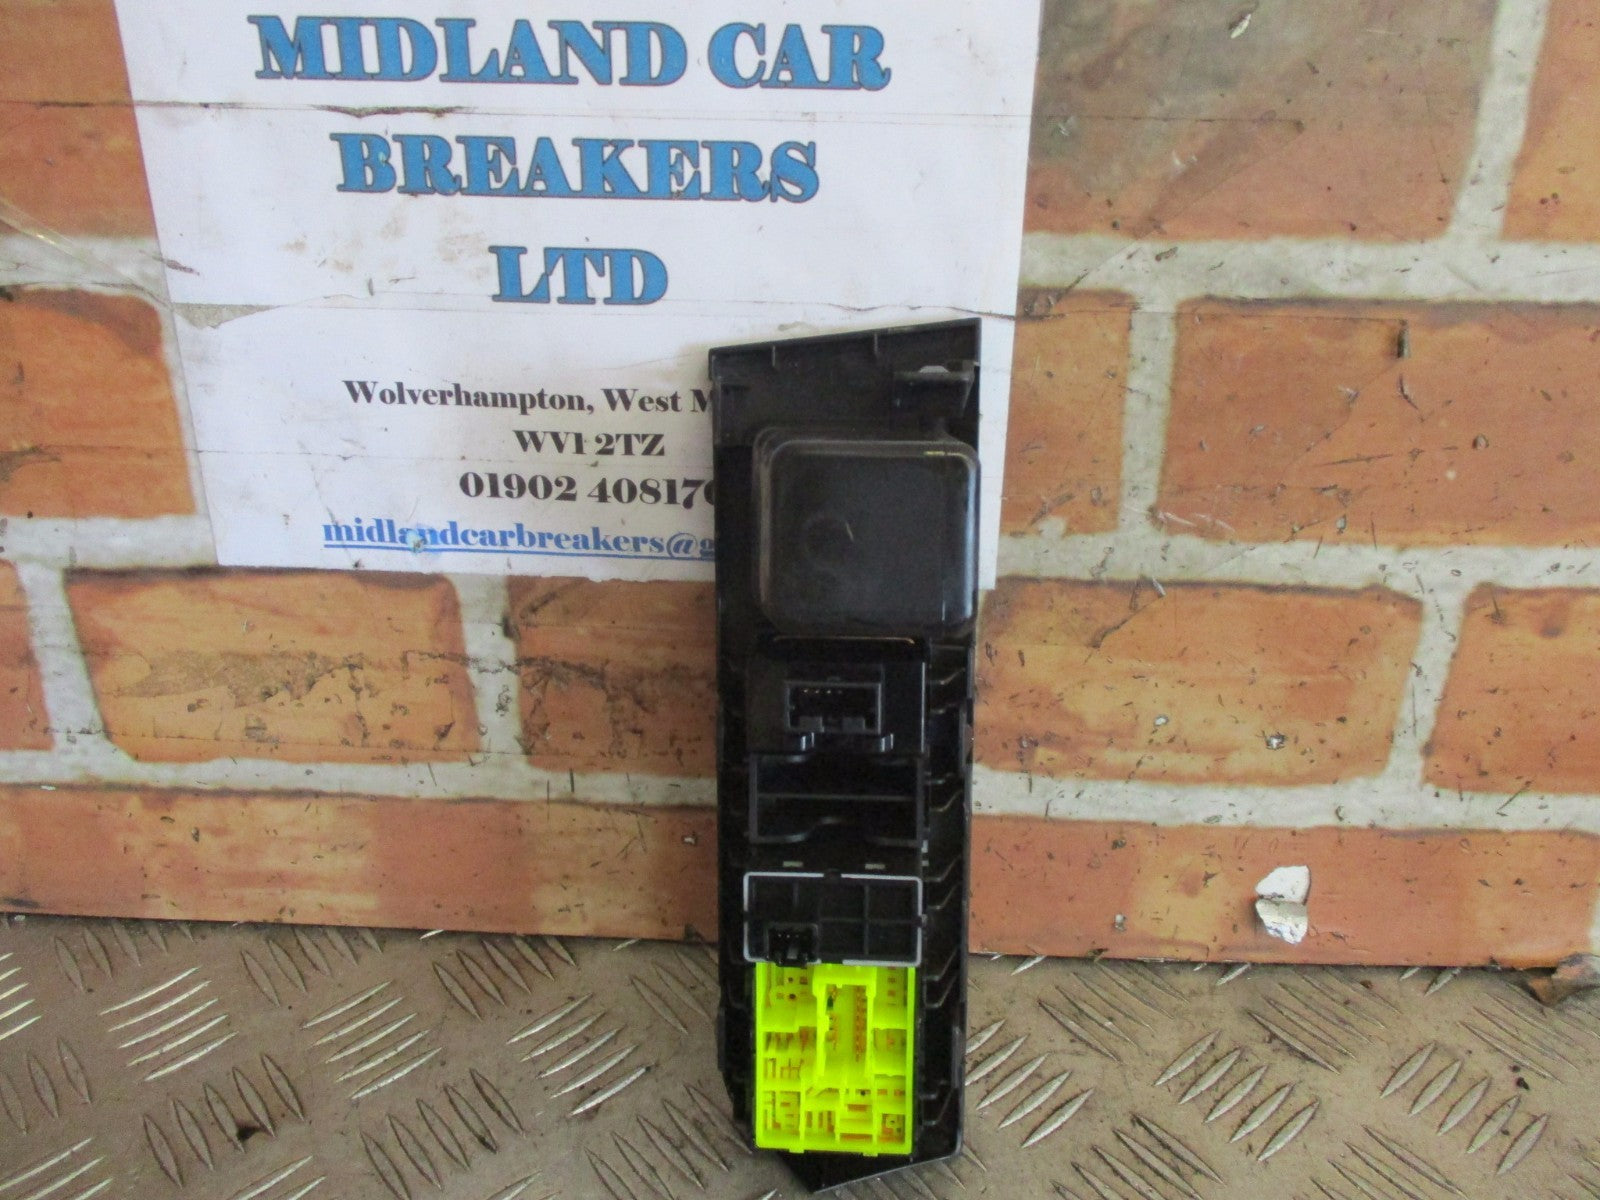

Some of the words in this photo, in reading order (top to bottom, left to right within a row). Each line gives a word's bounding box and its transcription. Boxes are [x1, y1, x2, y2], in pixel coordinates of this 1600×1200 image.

[247, 15, 688, 86] MIDLAND
[707, 22, 891, 91] CAR
[330, 132, 820, 203] BREAKERS
[489, 245, 669, 305] LTD
[342, 380, 595, 415] Wolverhampton,
[601, 388, 682, 413] West
[513, 430, 586, 454] WV1
[595, 433, 665, 456] 2TZ
[459, 472, 577, 501] 01902
